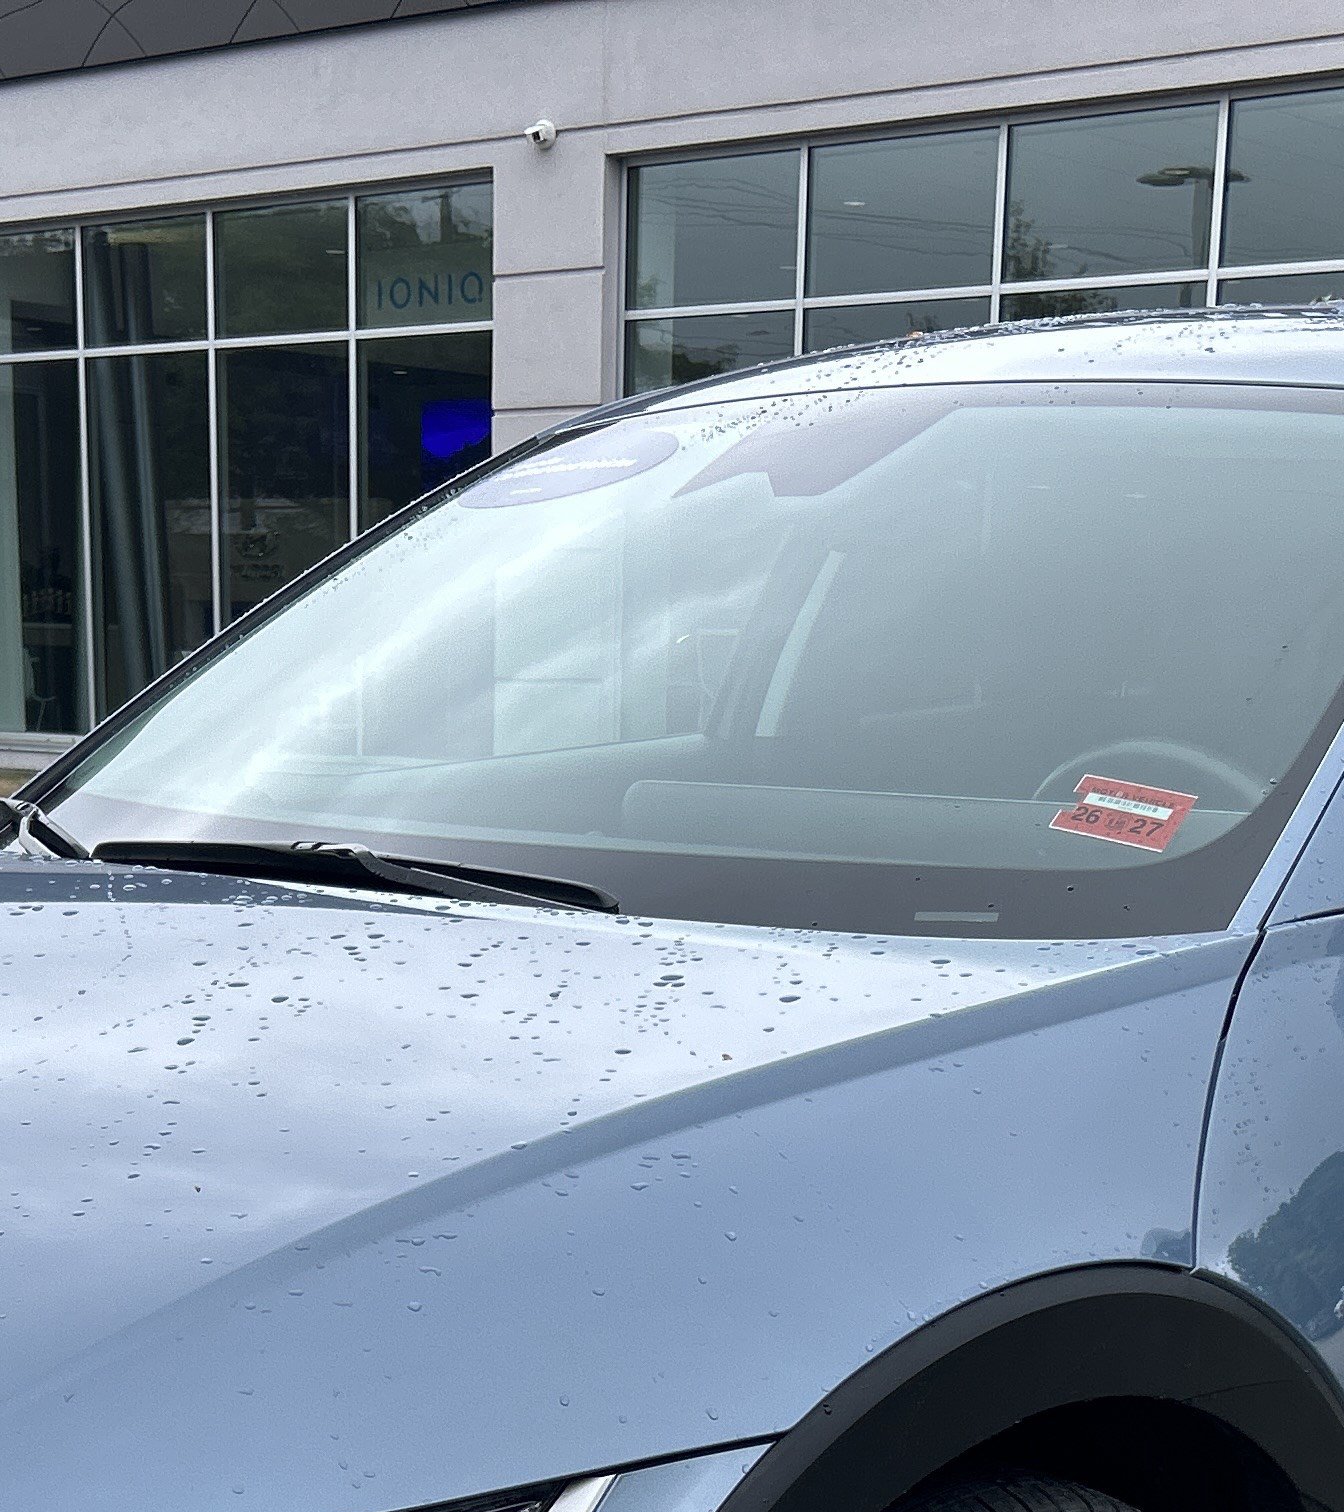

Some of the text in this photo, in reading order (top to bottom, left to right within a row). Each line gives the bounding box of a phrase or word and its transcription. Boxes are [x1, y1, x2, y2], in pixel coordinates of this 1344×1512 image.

[376, 270, 484, 312] IONIQ
[1071, 806, 1103, 825] 26
[1128, 818, 1165, 838] 27
